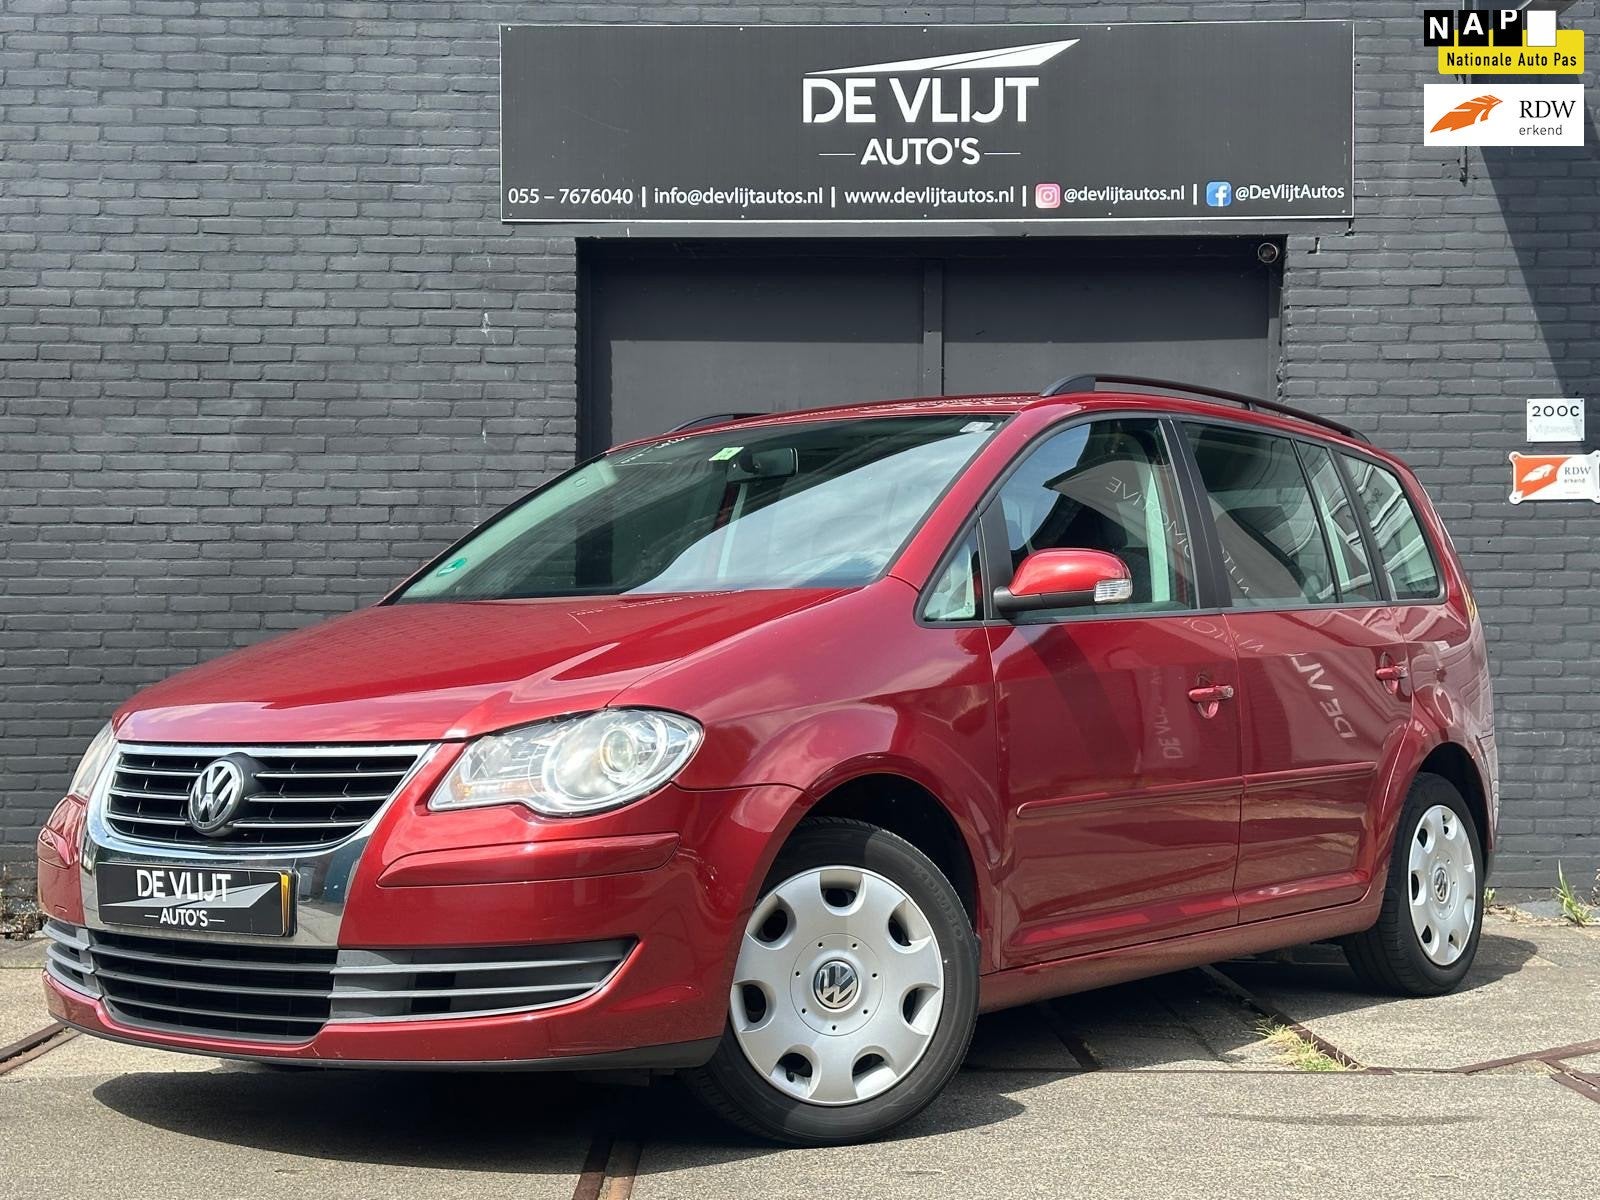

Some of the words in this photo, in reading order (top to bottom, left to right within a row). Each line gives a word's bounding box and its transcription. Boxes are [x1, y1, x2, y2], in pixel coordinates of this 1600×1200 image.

[802, 77, 877, 123] DE
[888, 77, 1040, 124] VLIJT
[860, 137, 981, 166] AUTO'S
[508, 187, 540, 204] 055
[558, 188, 634, 205] 7676040
[654, 186, 823, 208] info@devlijtautos.nl
[844, 185, 1014, 208] www.devlijtautos.nl
[1063, 183, 1185, 206] @devlijtautos.nl
[1235, 182, 1345, 203] @DeVlijtAutos
[1532, 405, 1580, 417] 200C
[1564, 466, 1592, 475] RDW
[136, 869, 165, 899] DE
[168, 871, 232, 902] VLIJT
[159, 907, 209, 928] AUTO'S
